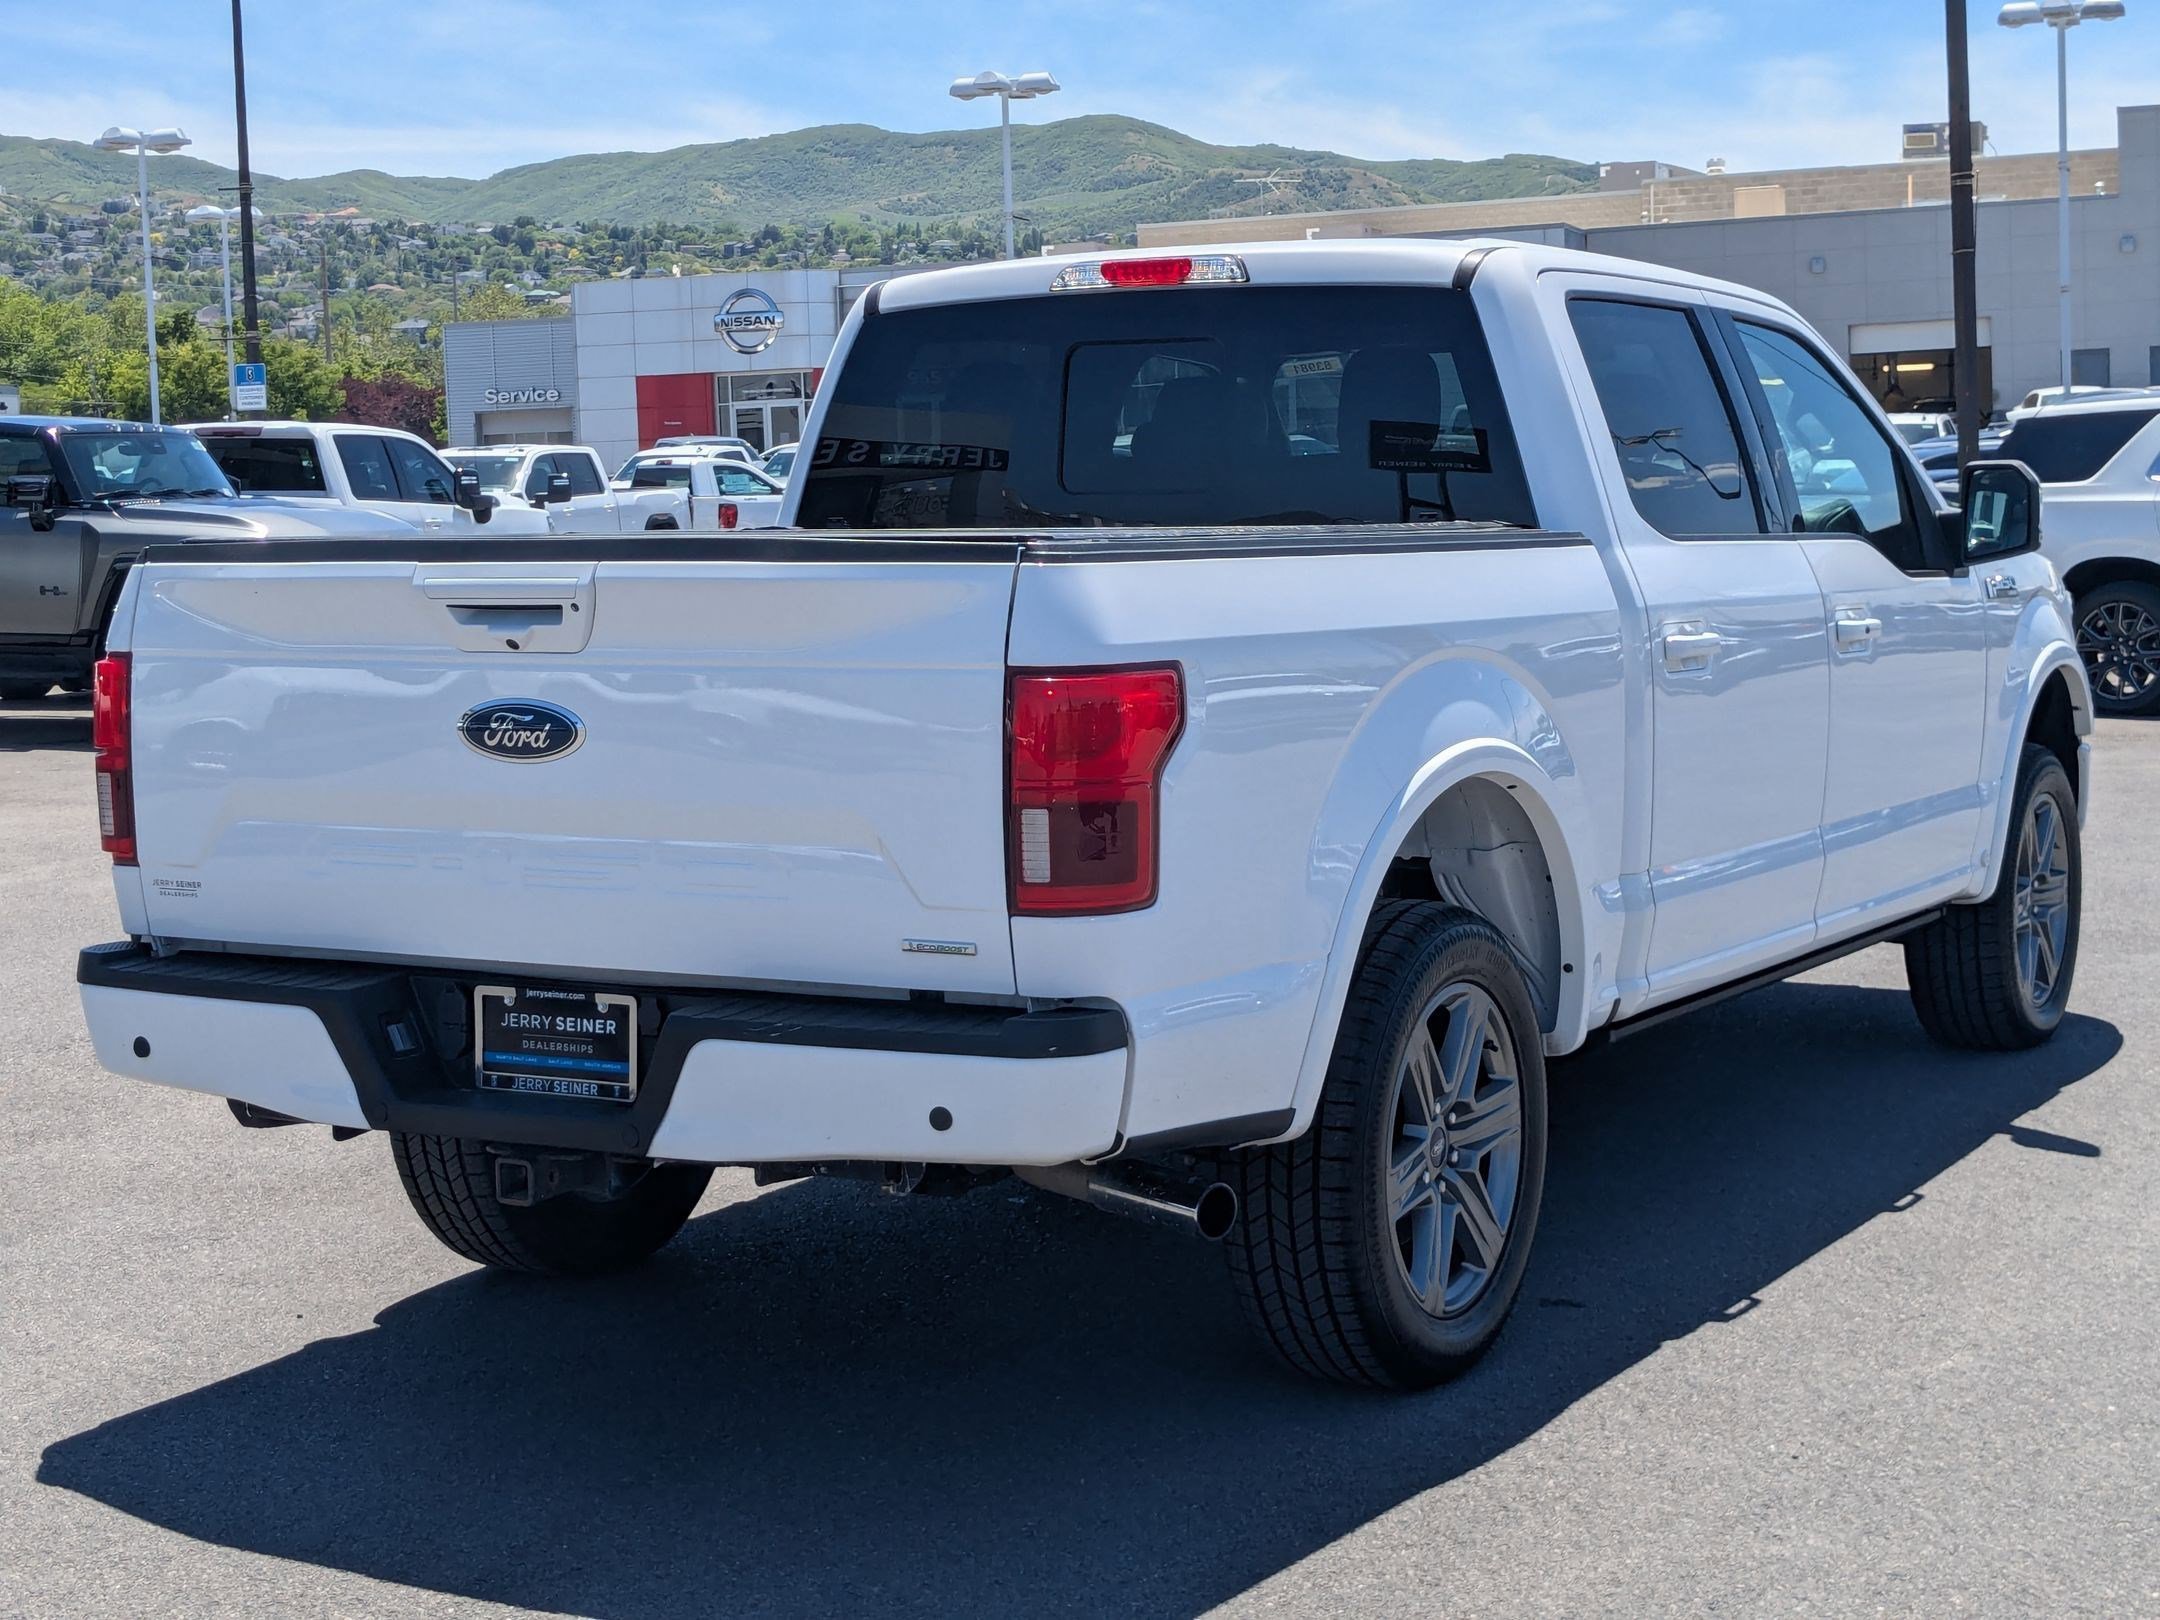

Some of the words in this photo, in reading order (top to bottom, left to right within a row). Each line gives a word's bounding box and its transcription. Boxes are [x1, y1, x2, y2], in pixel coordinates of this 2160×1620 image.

[720, 315, 776, 328] NISSAN
[485, 387, 560, 404] Service
[484, 712, 552, 748] Ford
[152, 879, 175, 887] JERRY
[176, 880, 202, 889] SEINER
[526, 988, 586, 1000] jerryseiner.com
[501, 1012, 552, 1029] JERRY
[555, 1016, 616, 1034] SEINER
[522, 1040, 594, 1054] DEALERSHIPS
[512, 1077, 552, 1092] JERRY
[553, 1080, 598, 1096] SEINER
